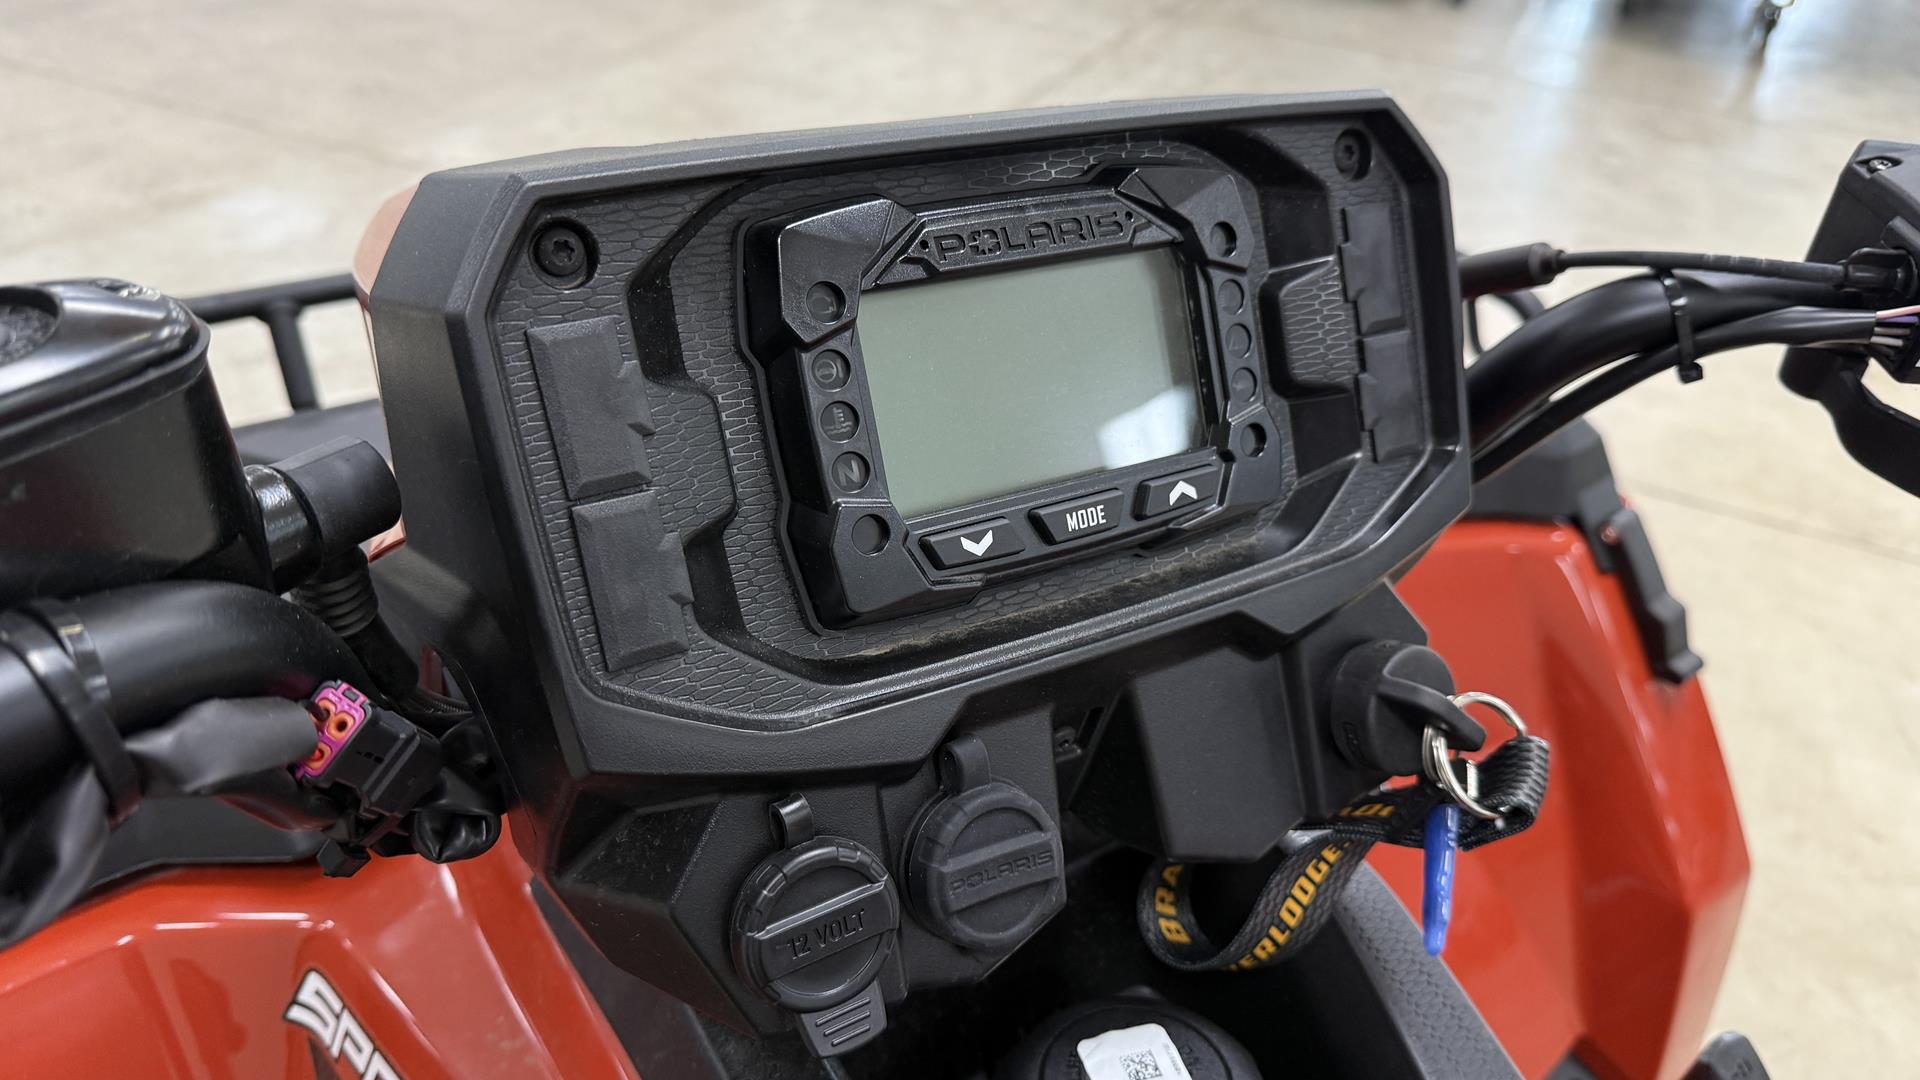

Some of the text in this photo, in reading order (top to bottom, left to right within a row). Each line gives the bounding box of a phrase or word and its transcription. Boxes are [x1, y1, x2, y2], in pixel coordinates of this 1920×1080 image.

[933, 211, 1124, 264] POLARIS
[836, 458, 863, 488] N
[1066, 504, 1107, 532] MODE
[949, 850, 1054, 899] POLARIS
[786, 908, 865, 960] 12 VOLT
